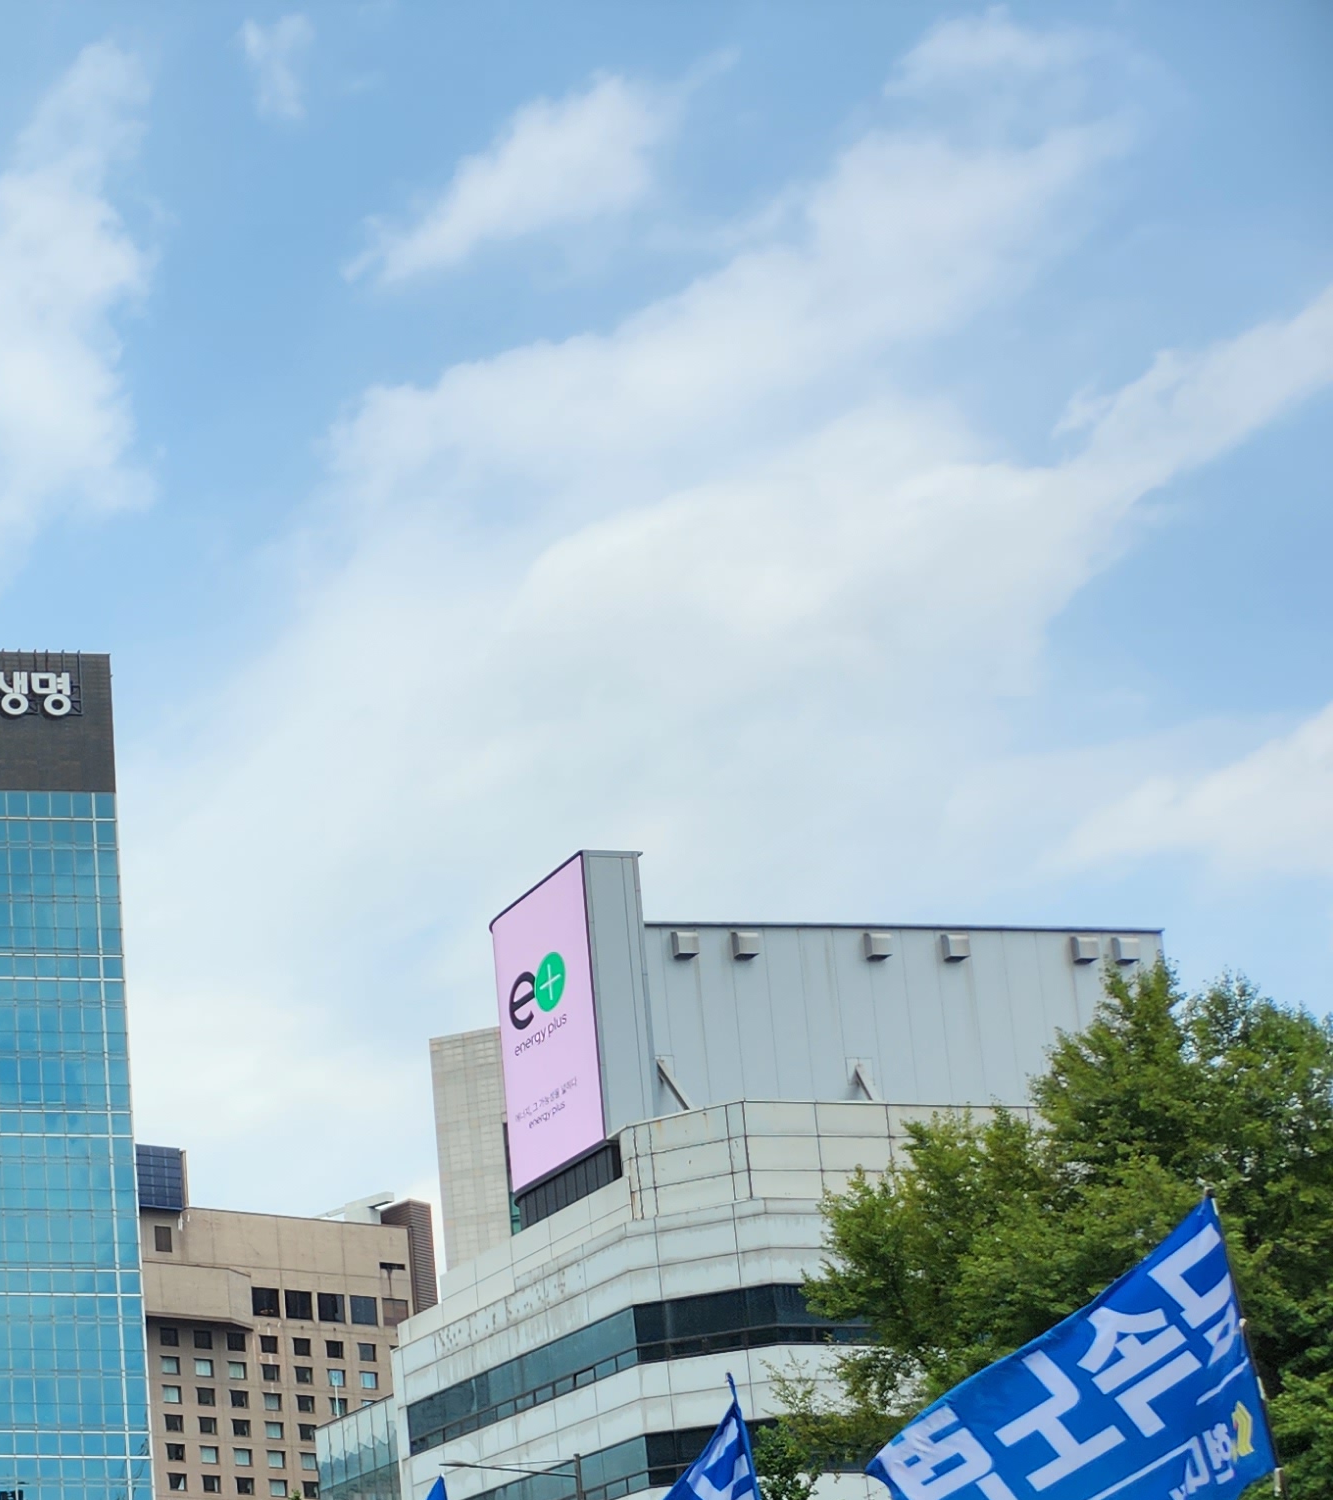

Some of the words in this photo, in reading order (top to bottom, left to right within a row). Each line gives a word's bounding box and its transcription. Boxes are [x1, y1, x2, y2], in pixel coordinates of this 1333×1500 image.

[514, 1027, 547, 1056] energy
[547, 1013, 567, 1039] plus
[529, 1110, 551, 1129] energy
[551, 1102, 566, 1118] plus
